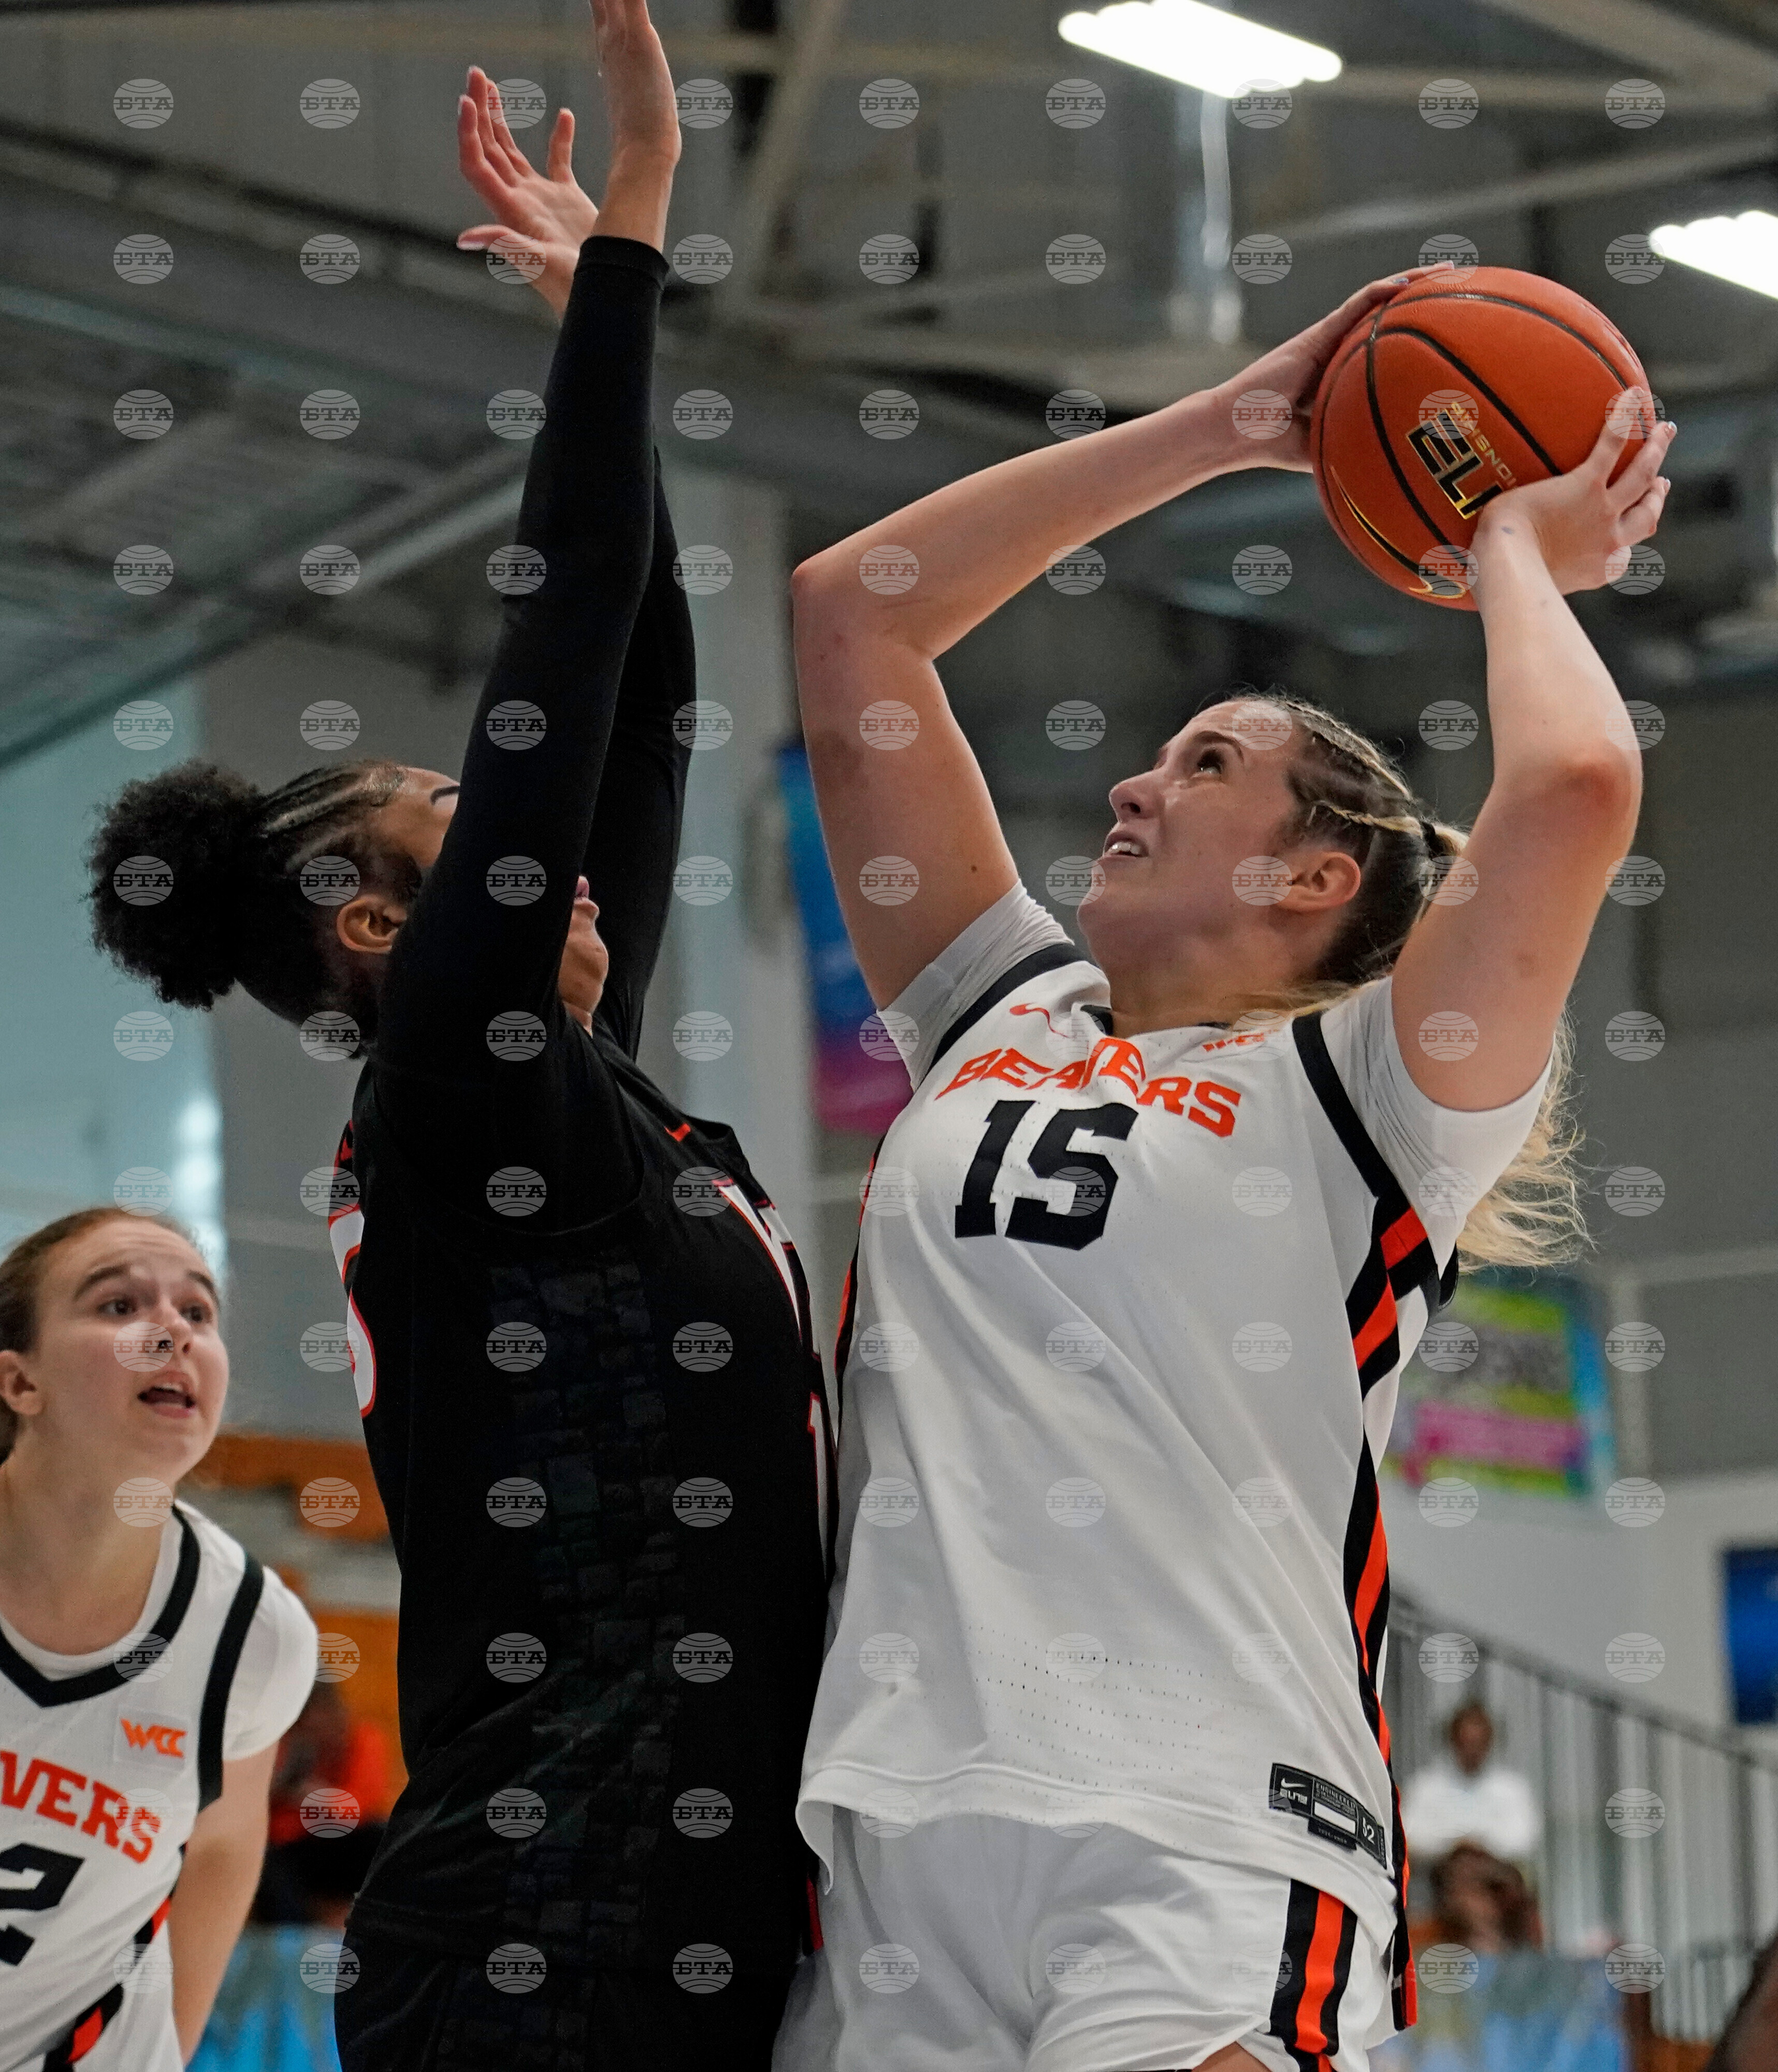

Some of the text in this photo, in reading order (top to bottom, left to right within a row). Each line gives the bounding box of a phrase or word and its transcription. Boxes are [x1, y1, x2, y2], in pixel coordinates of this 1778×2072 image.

[1405, 407, 1503, 520] ELI
[955, 1100, 1138, 1251] 15
[0, 1749, 162, 1863] VERS
